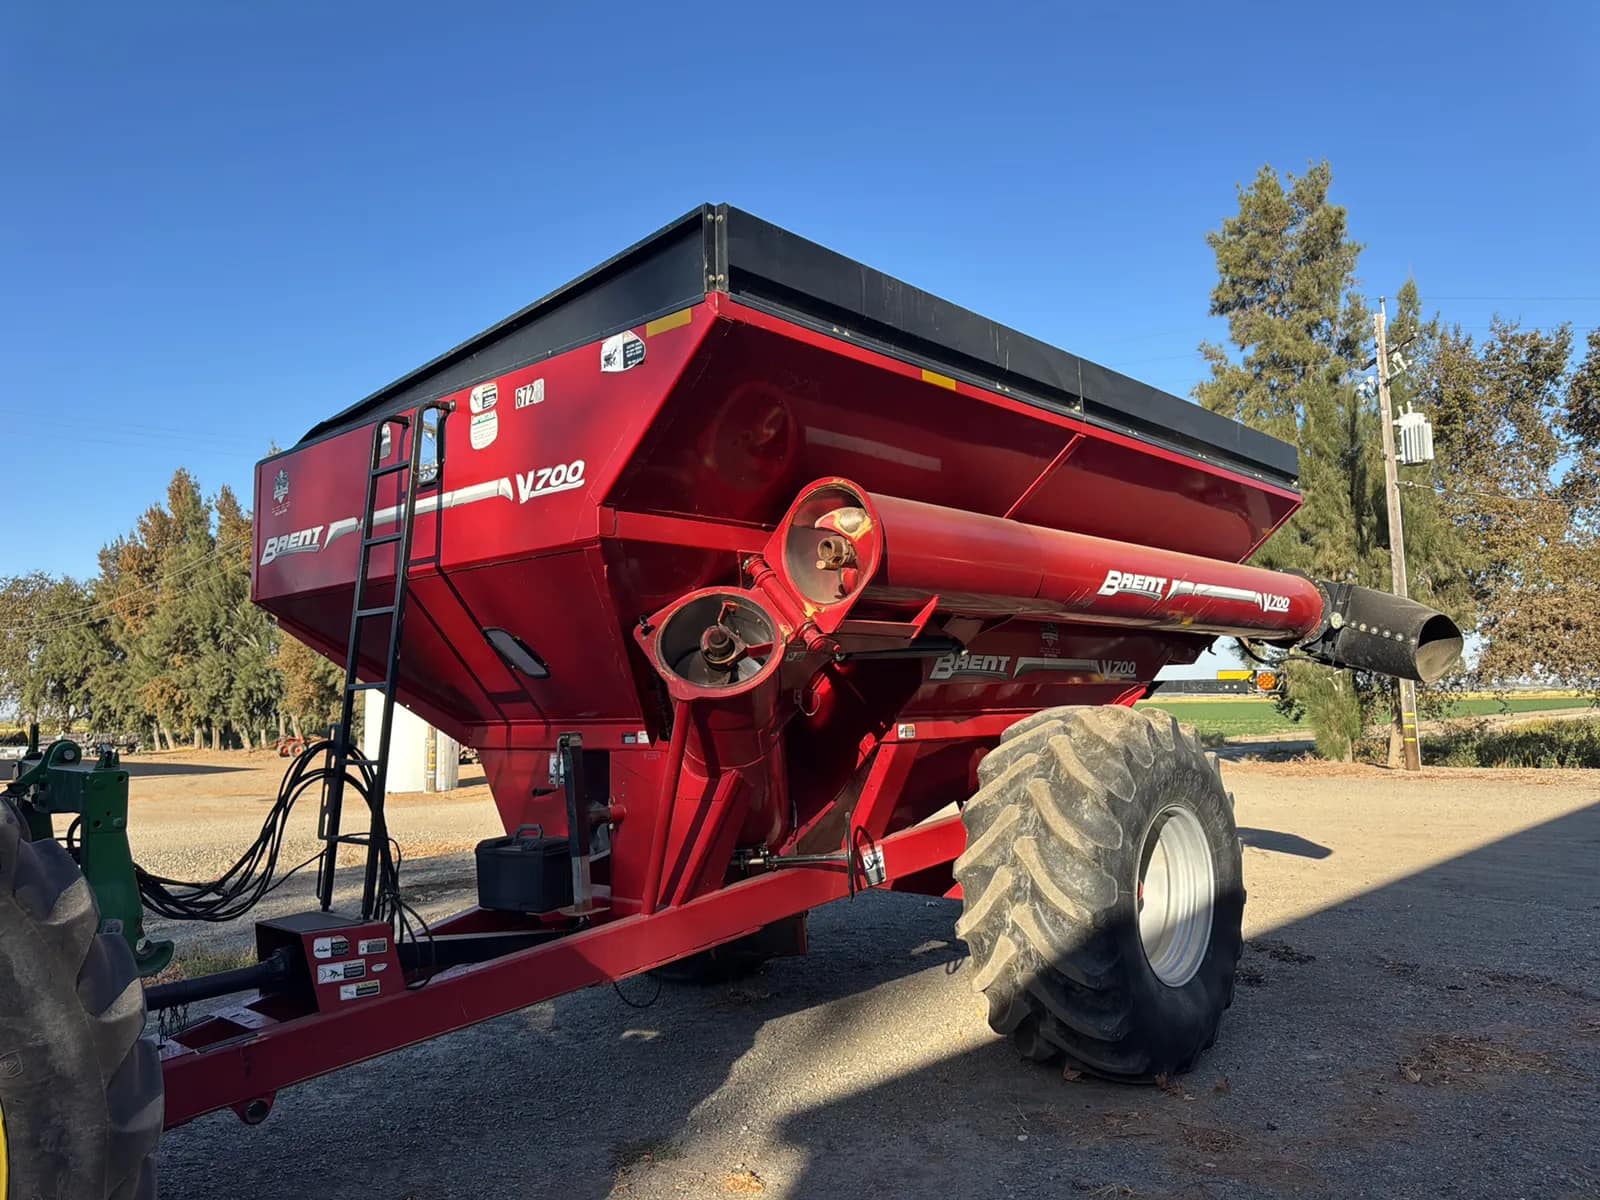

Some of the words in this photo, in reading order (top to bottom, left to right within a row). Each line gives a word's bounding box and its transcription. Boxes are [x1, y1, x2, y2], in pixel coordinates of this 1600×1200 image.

[260, 526, 324, 566] BRENT
[515, 459, 585, 505] V700
[1097, 569, 1168, 597] BRENT
[1263, 592, 1290, 612] V700
[929, 653, 1011, 680] BRENT
[1101, 659, 1137, 680] V700
